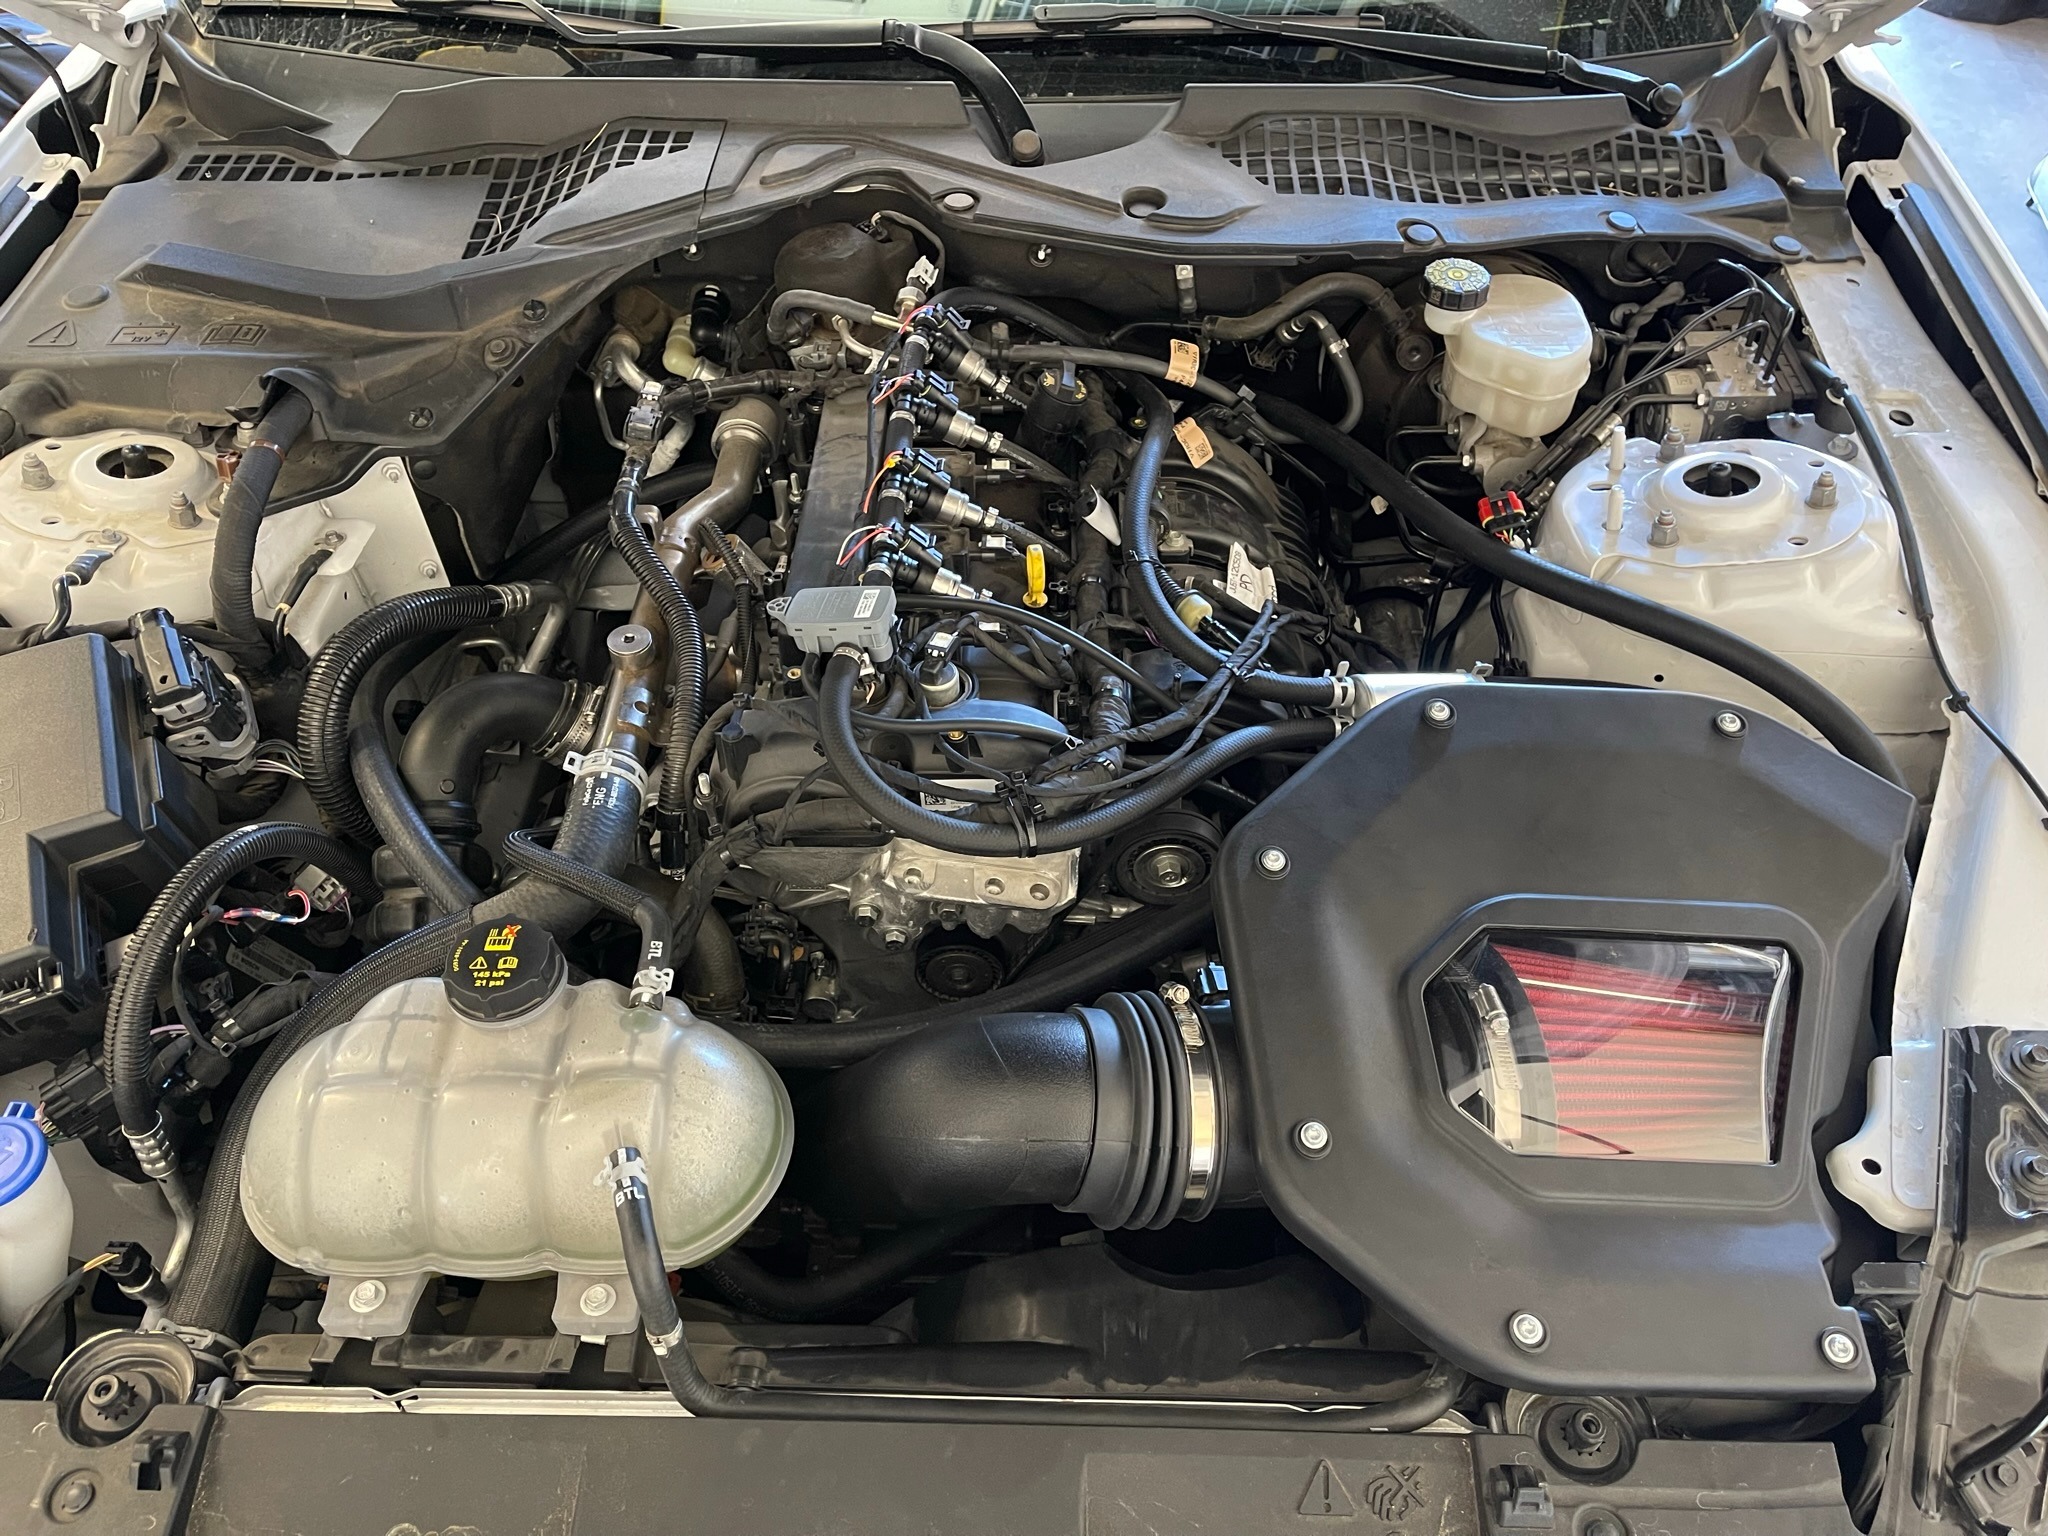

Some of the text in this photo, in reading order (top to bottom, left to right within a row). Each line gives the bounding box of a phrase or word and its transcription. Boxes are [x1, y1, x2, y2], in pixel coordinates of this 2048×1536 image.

[1239, 573, 1253, 593] PD
[647, 940, 663, 960] BTL
[488, 979, 505, 988] psi
[615, 1186, 646, 1208] BTL
